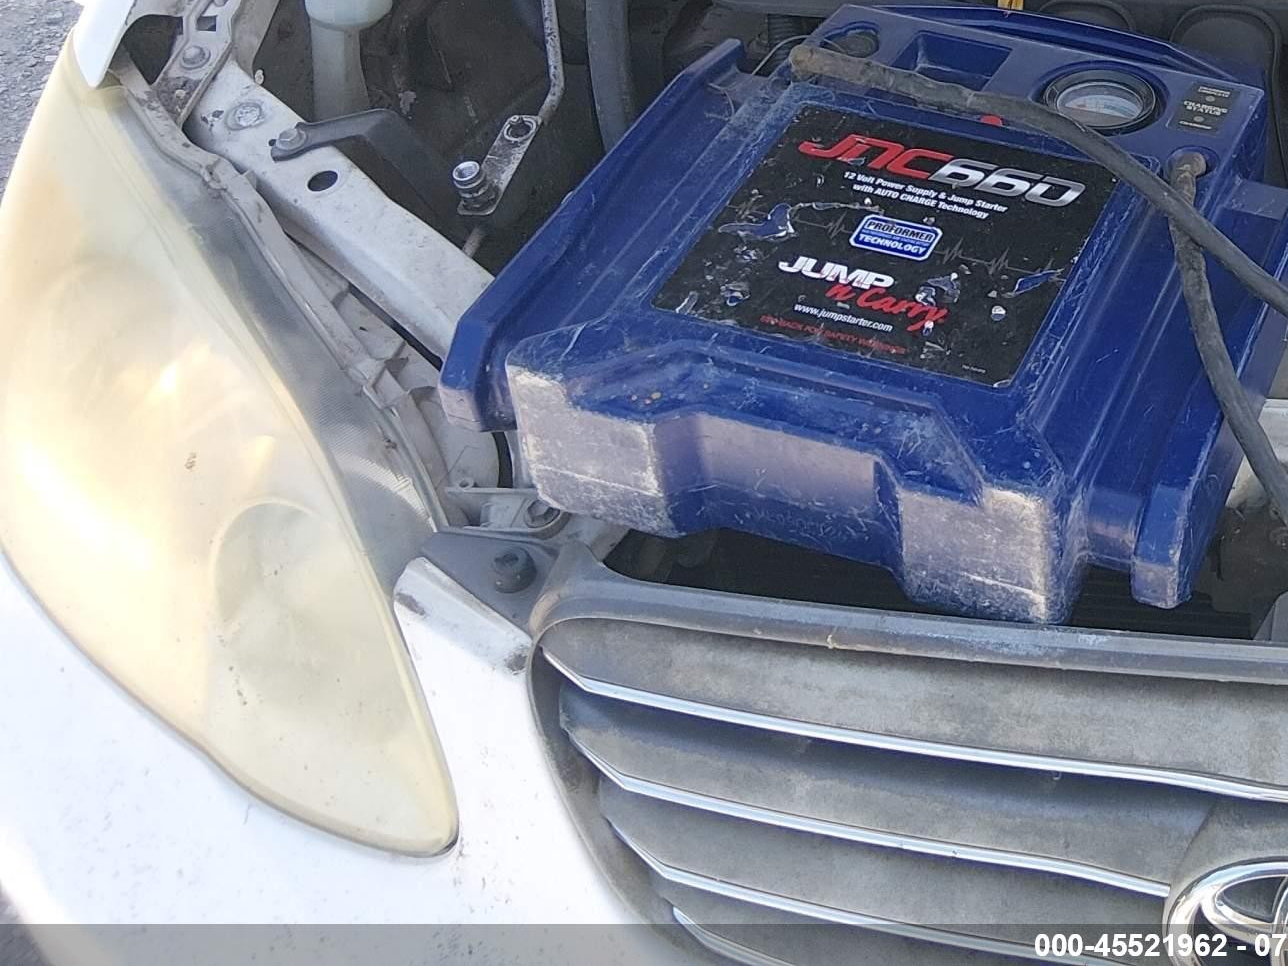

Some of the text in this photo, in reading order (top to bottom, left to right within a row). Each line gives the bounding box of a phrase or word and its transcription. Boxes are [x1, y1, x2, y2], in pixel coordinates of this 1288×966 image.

[799, 134, 1085, 207] JNC660
[844, 171, 1008, 212] 12 Volt Power Supply & Jump Starter
[852, 184, 989, 219] with AUTO CHARGE Technology
[859, 234, 926, 254] TECHNOLOGY
[867, 221, 934, 242] PROFORMER
[778, 256, 894, 289] JUMP
[794, 303, 893, 332] www.jumpstarter.com
